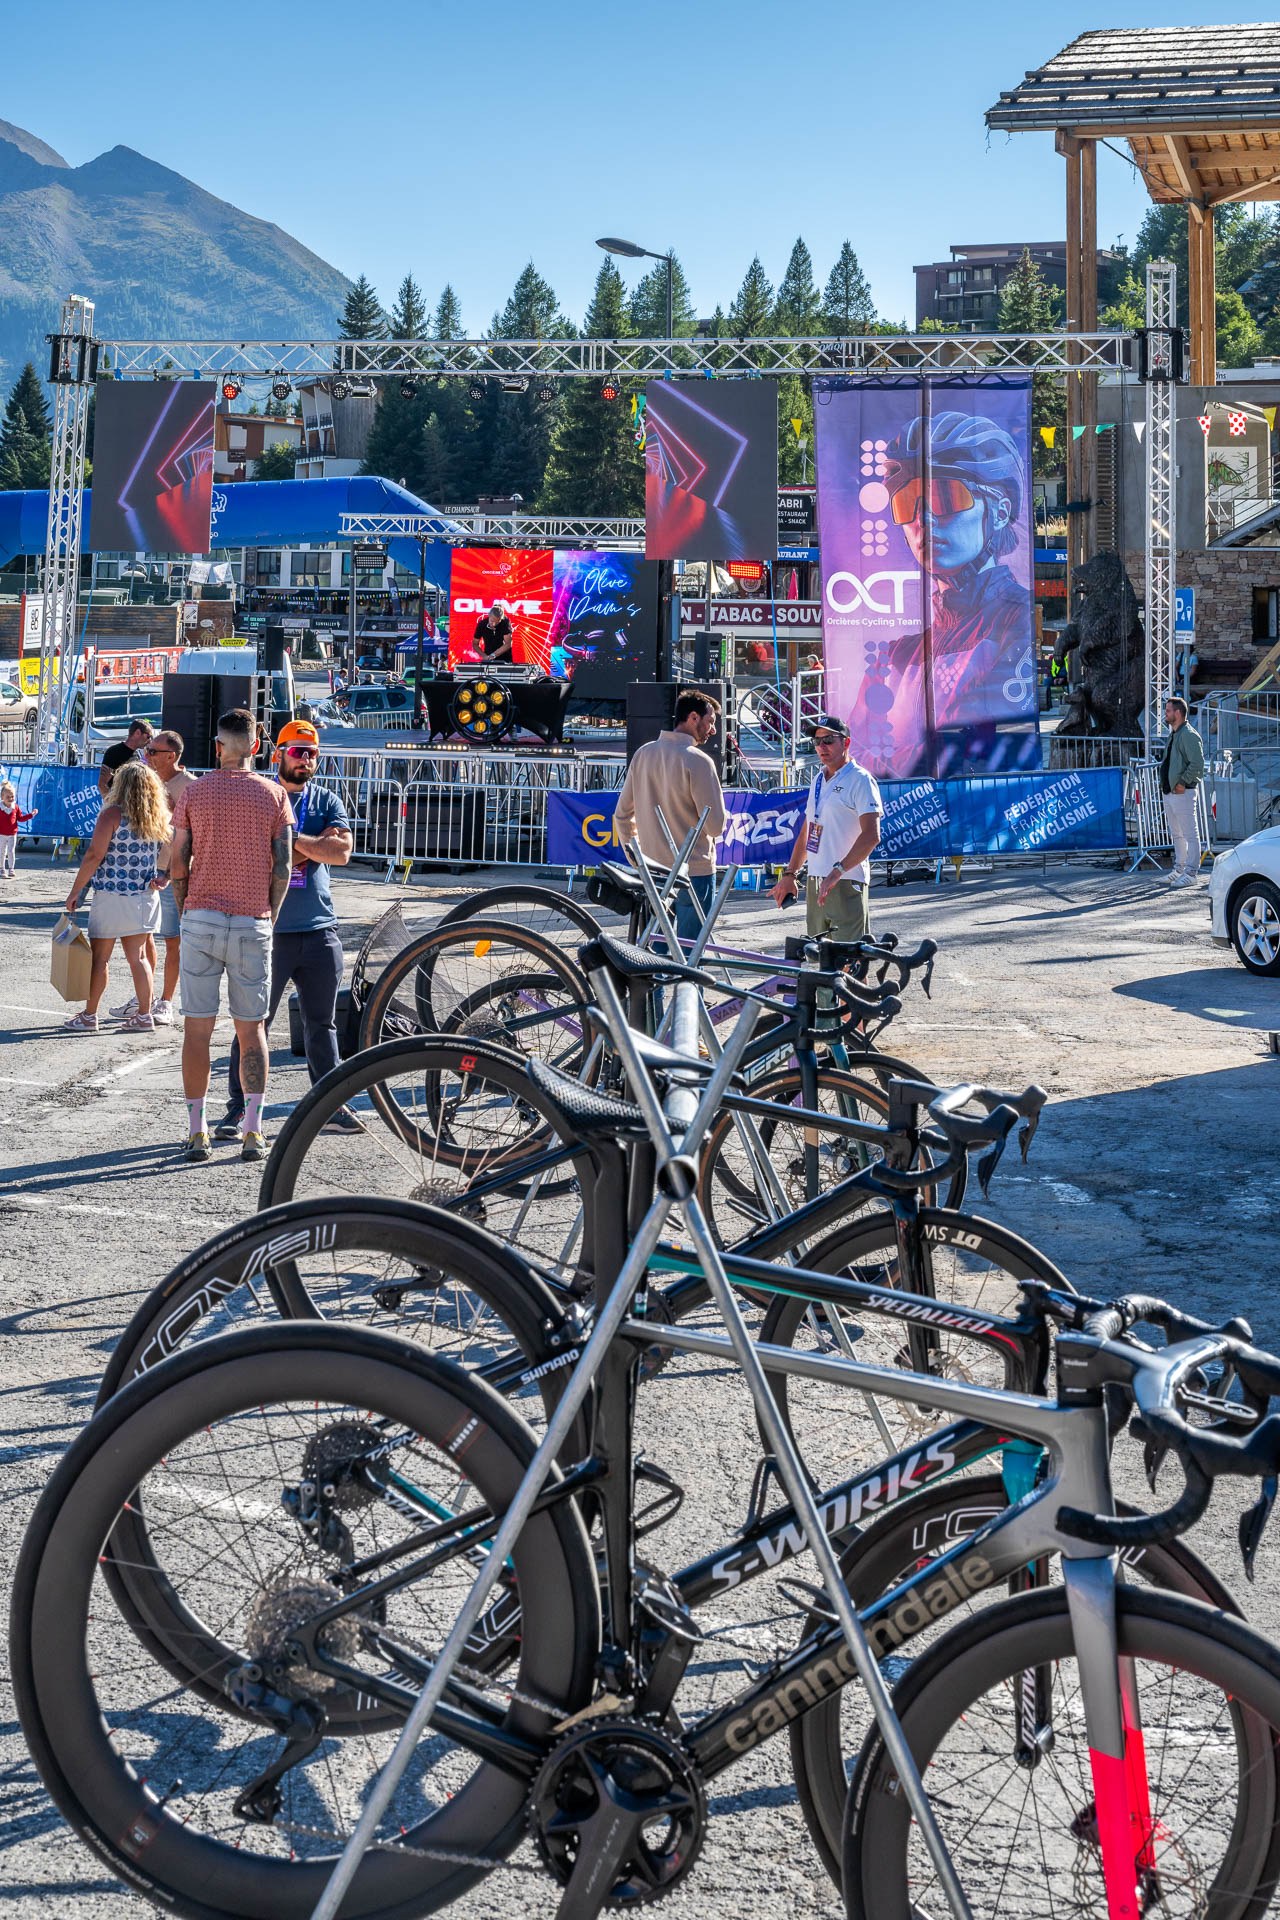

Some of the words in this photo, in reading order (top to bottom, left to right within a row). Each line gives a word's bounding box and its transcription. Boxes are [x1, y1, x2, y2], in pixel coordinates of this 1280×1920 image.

[445, 506, 453, 514] LE
[453, 505, 481, 514] CHAMPSAUR
[584, 568, 628, 595] Olive
[711, 607, 763, 623] TABAC
[827, 617, 860, 627] Orcières
[861, 618, 895, 627] Cycling
[897, 618, 922, 626] Team
[1003, 772, 1082, 822] FÉDÉRATION
[1010, 786, 1090, 836] FRANÇAISE
[886, 810, 951, 853] CYCLISME
[1029, 801, 1098, 846] CYCLISME
[952, 1230, 983, 1250] DT
[861, 1293, 994, 1334] SPECIALIZED
[520, 1348, 580, 1386] SHIMANO
[710, 1434, 955, 1598] S-WORKS
